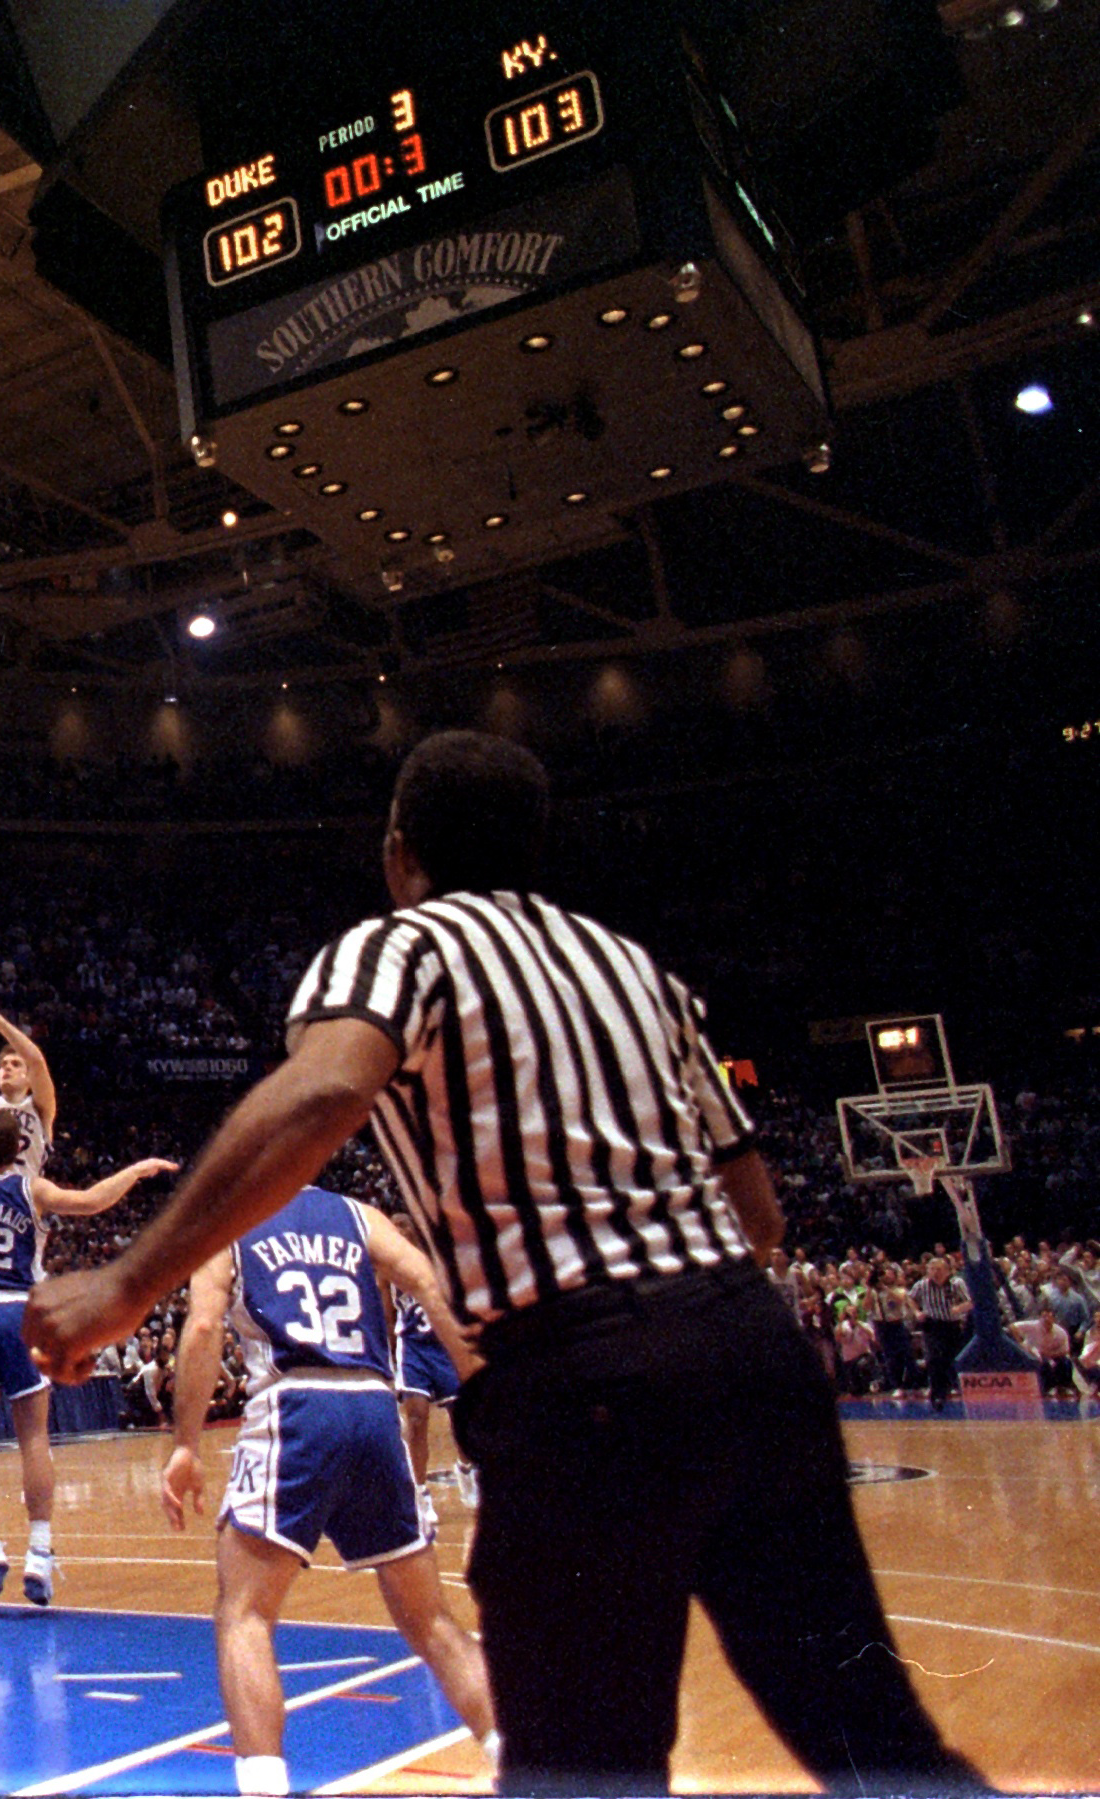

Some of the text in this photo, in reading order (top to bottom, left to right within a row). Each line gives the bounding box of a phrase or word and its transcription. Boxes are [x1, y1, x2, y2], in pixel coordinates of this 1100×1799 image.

[502, 34, 558, 79] KY.
[318, 89, 416, 153] PERIOD 3
[504, 89, 585, 156] 103
[207, 154, 276, 207] DUKE
[325, 172, 465, 241] OFFICIAL TIME
[218, 213, 285, 271] 102
[256, 231, 566, 374] SOUTHERN COMFORT
[250, 1231, 362, 1275] FARMER
[276, 1270, 364, 1354] 32
[963, 1376, 1013, 1389] NCAA
